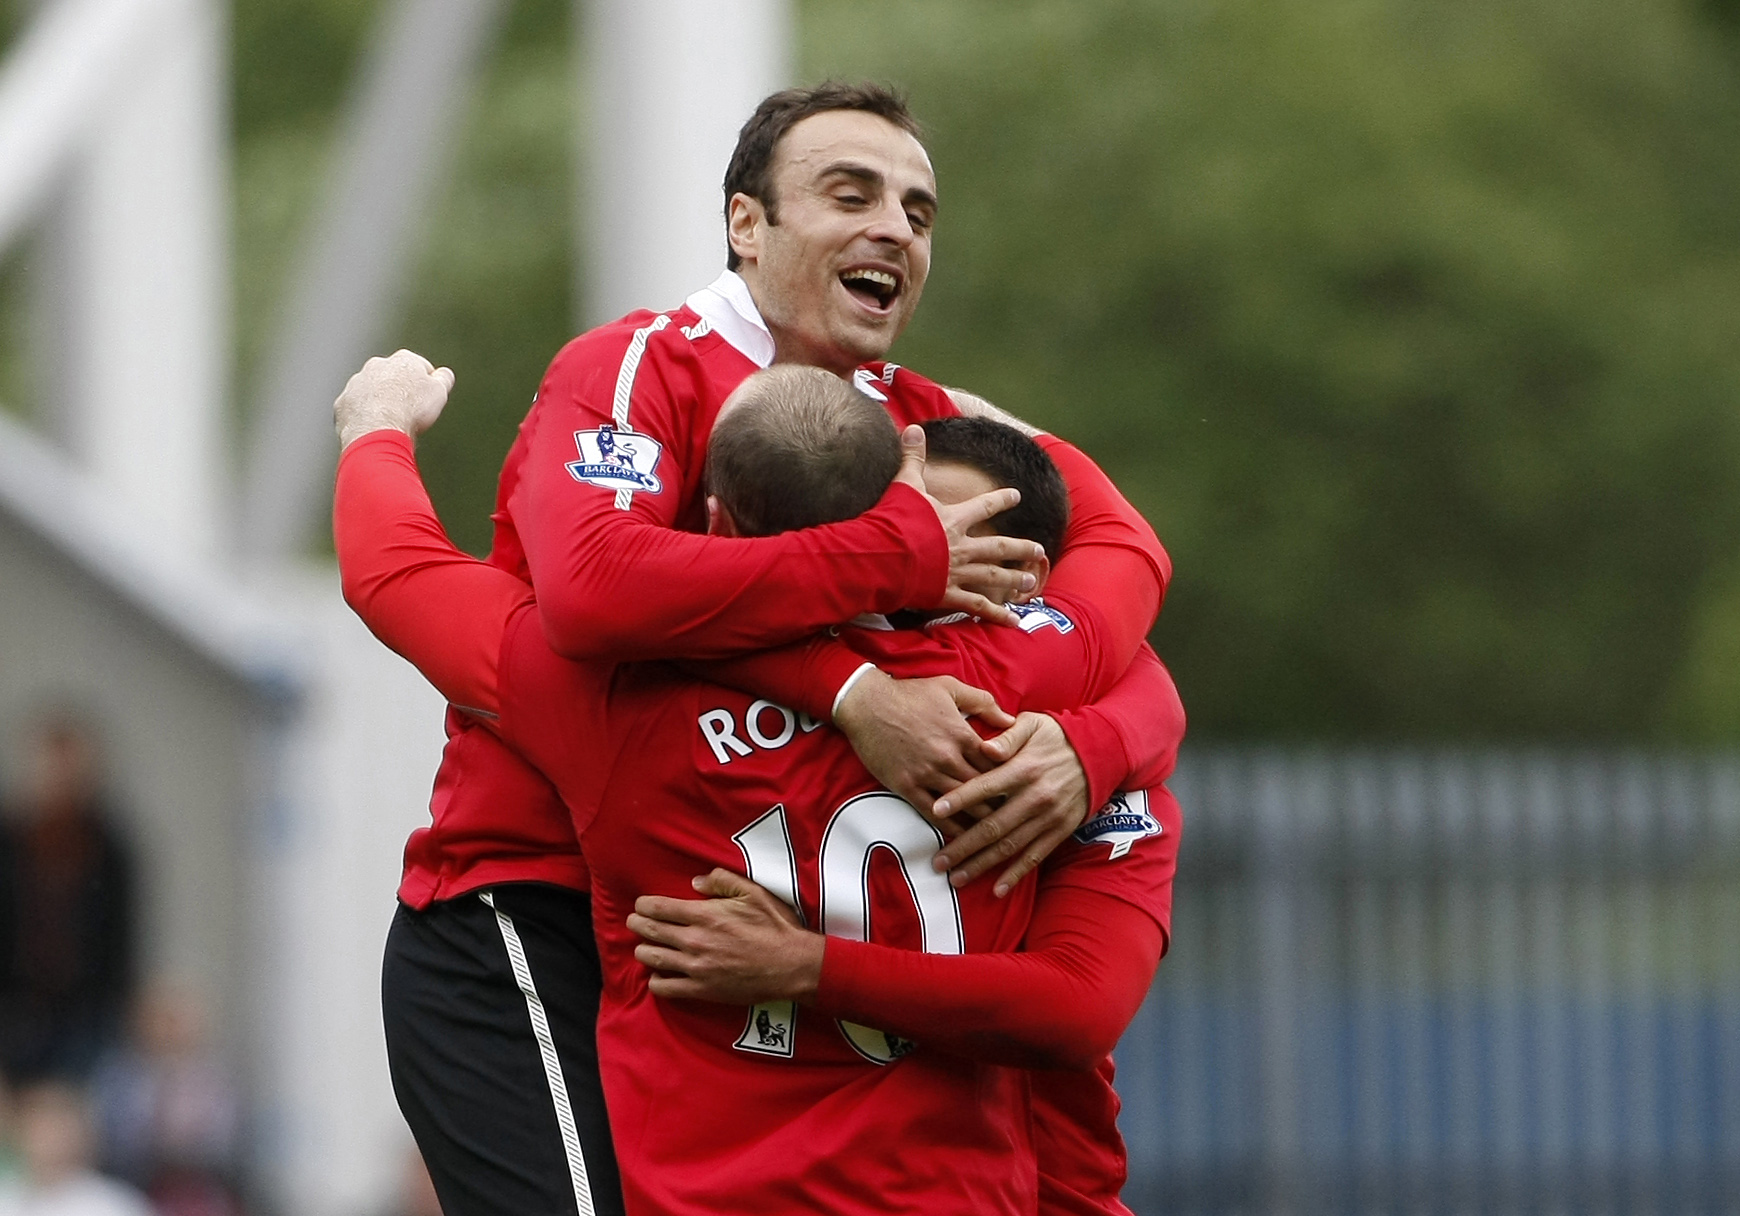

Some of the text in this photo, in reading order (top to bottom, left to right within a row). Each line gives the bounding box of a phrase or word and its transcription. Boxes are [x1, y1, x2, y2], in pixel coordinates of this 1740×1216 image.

[584, 465, 639, 478] BARCLAYS
[1084, 815, 1138, 834] BARCLAYS
[731, 790, 965, 1067] 10
